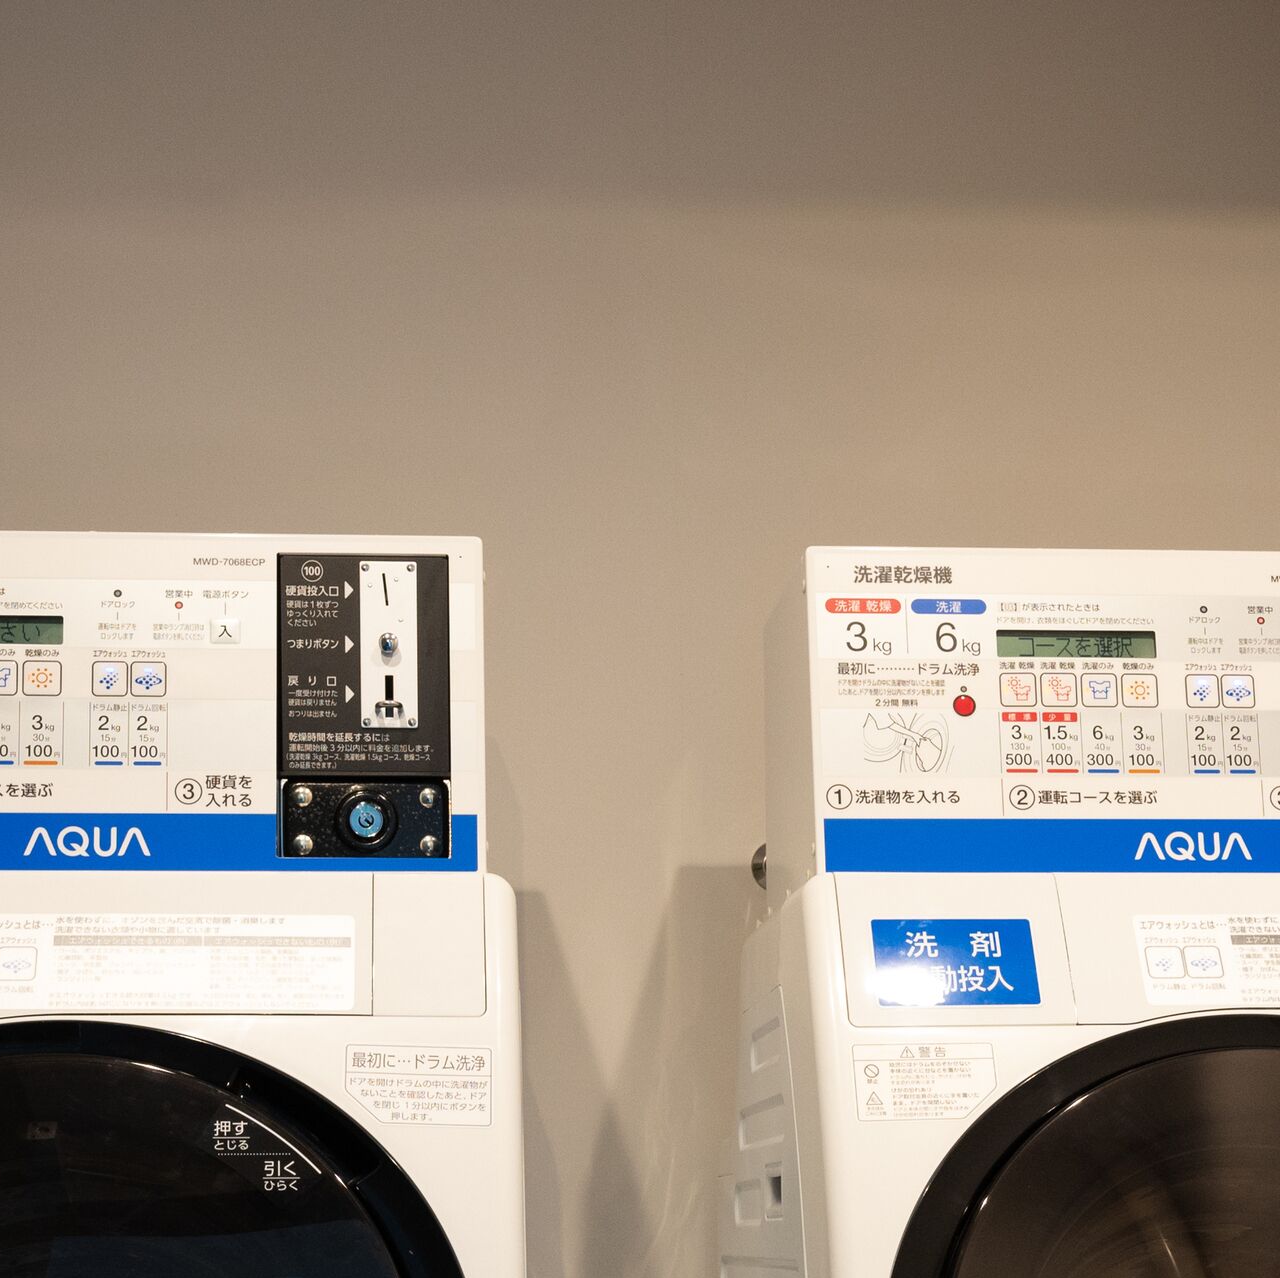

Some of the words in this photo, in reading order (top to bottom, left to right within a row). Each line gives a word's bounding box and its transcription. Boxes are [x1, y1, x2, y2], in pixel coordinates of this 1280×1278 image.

[193, 558, 266, 566] MWD-7068ECP
[304, 567, 320, 576] 100
[854, 566, 952, 585] 洗濯乾燥機
[165, 590, 193, 598] 営業中
[203, 590, 249, 598] 電源ボタン
[286, 585, 339, 597] 硬貨投入口
[835, 600, 861, 612] 洗濯
[866, 600, 892, 612] 乾燥
[936, 601, 962, 613] 洗濯
[1248, 606, 1273, 614] 営業中
[287, 610, 338, 618] ゆっくり入れて
[288, 619, 317, 627] ください
[219, 625, 232, 638] 入
[287, 639, 339, 649] つまりボタン
[1019, 638, 1133, 657] コースを選択
[25, 649, 59, 657] 乾燥のみ
[131, 650, 166, 658] エアウォッシュ
[93, 704, 127, 712] ドラム静止
[131, 704, 166, 712] ドラム回転
[288, 710, 337, 718] おつりは出ません
[289, 733, 390, 743] 乾燥時間を延長するには
[206, 775, 252, 790] 硬貨を
[206, 793, 252, 807] 入れる
[23, 826, 151, 857] AQUA
[1135, 831, 1252, 861] AQUA
[349, 1077, 487, 1089] ドアを開けドラムの中に洗濯物が
[214, 1120, 248, 1136] 押す
[214, 1140, 249, 1150] とじる
[264, 1161, 296, 1176] 引く
[264, 1180, 298, 1191] ひらく
